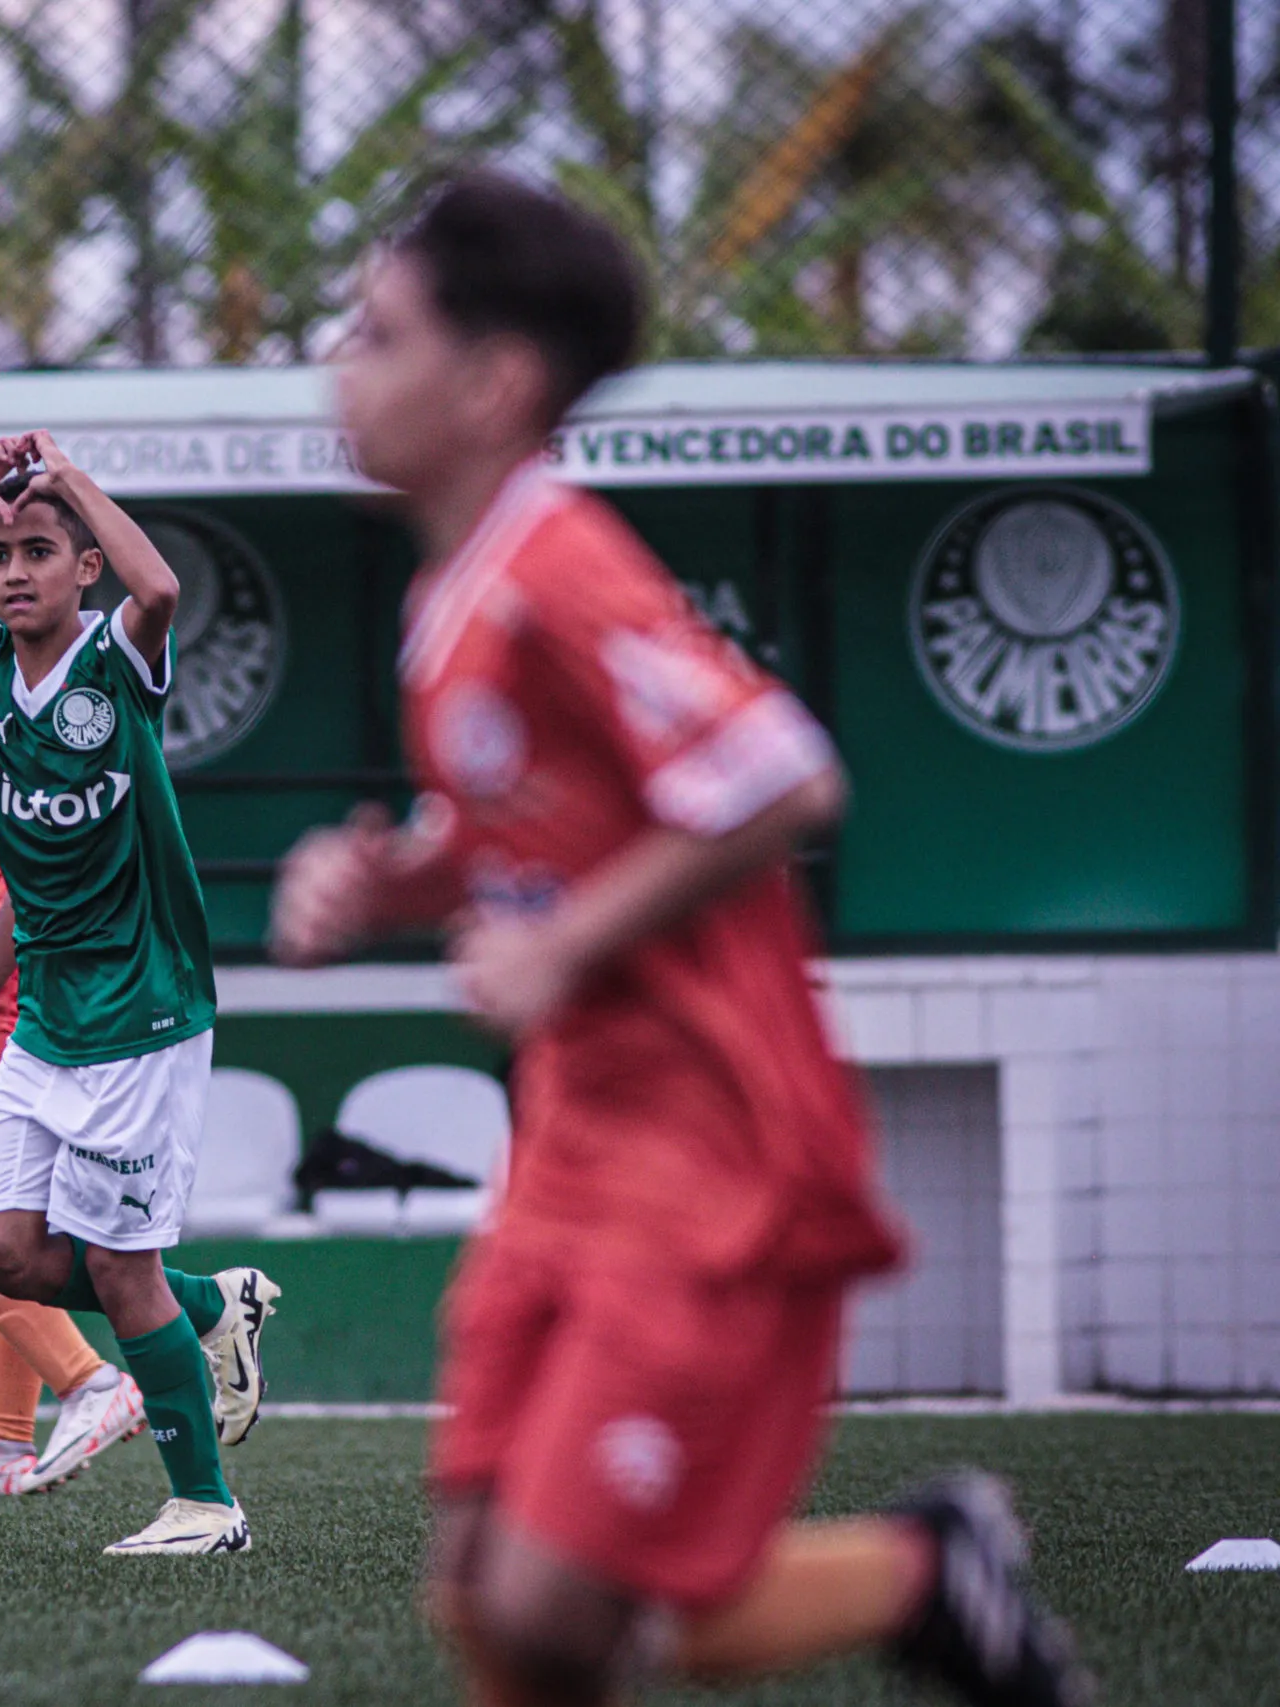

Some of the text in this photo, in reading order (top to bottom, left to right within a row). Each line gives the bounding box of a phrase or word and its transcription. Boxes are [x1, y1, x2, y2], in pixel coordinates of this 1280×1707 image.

[226, 434, 287, 475] DE
[299, 435, 357, 474] BA
[579, 425, 869, 466] VENCEDORA
[884, 423, 950, 460] DO
[962, 421, 1139, 458] BRASIL
[924, 598, 1164, 734] PALMEIRAS
[62, 702, 111, 745] PALMEIRAS
